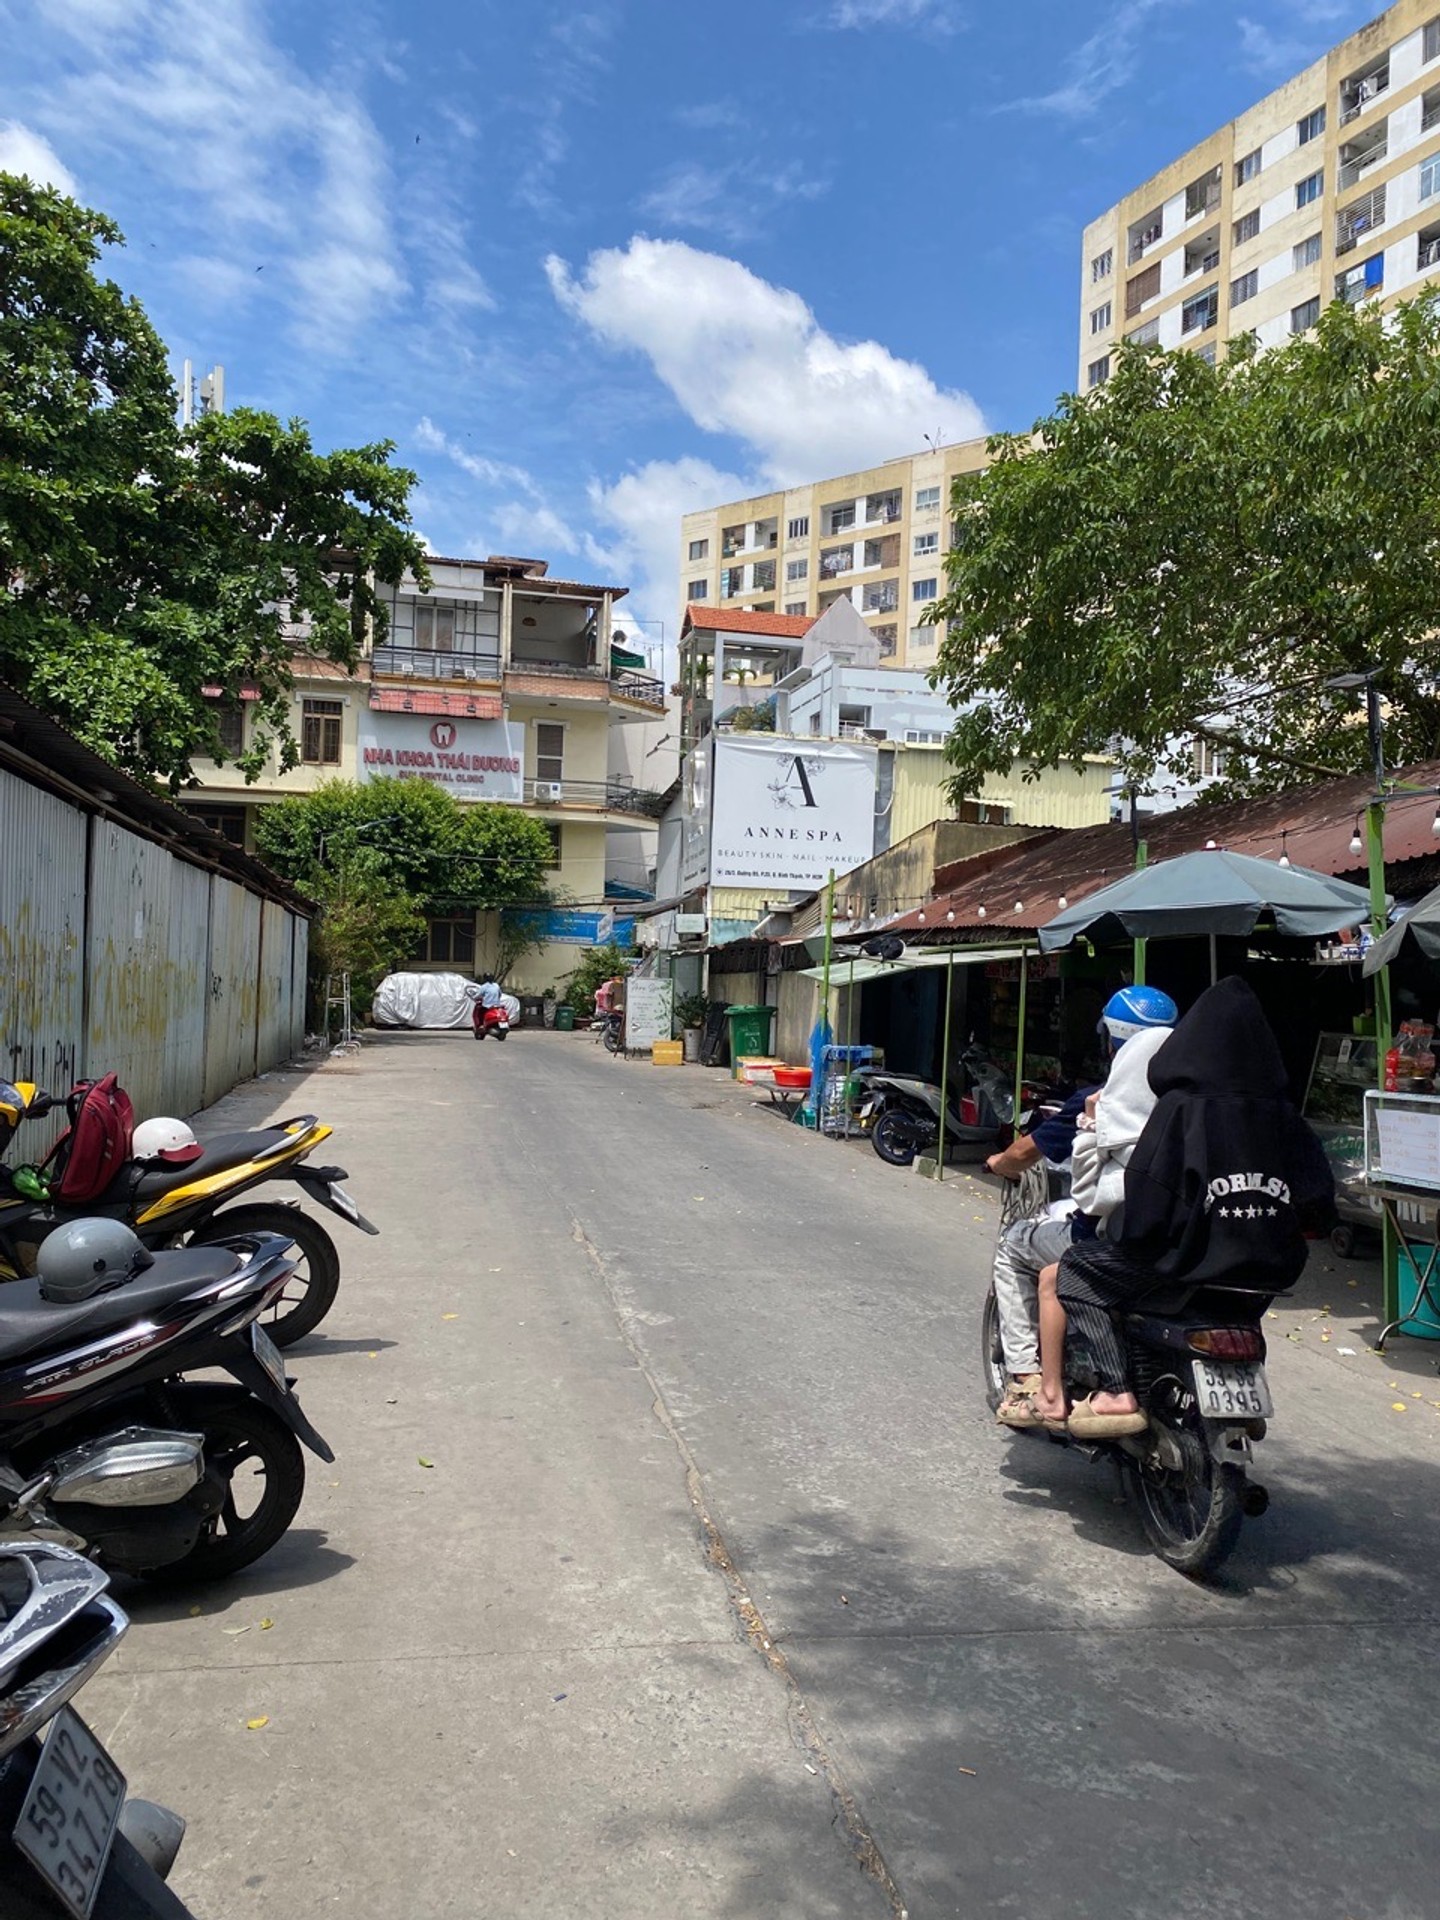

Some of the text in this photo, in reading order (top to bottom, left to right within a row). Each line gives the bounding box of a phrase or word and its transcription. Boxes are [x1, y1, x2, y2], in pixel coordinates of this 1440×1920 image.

[363, 747, 394, 765] NHA
[396, 749, 436, 768] KHOA
[456, 773, 485, 784] CLINIC
[743, 826, 842, 842] ANNE SPA
[792, 853, 816, 862] NAIL
[825, 855, 866, 864] MAKEUP
[1208, 1390, 1262, 1413] 0395
